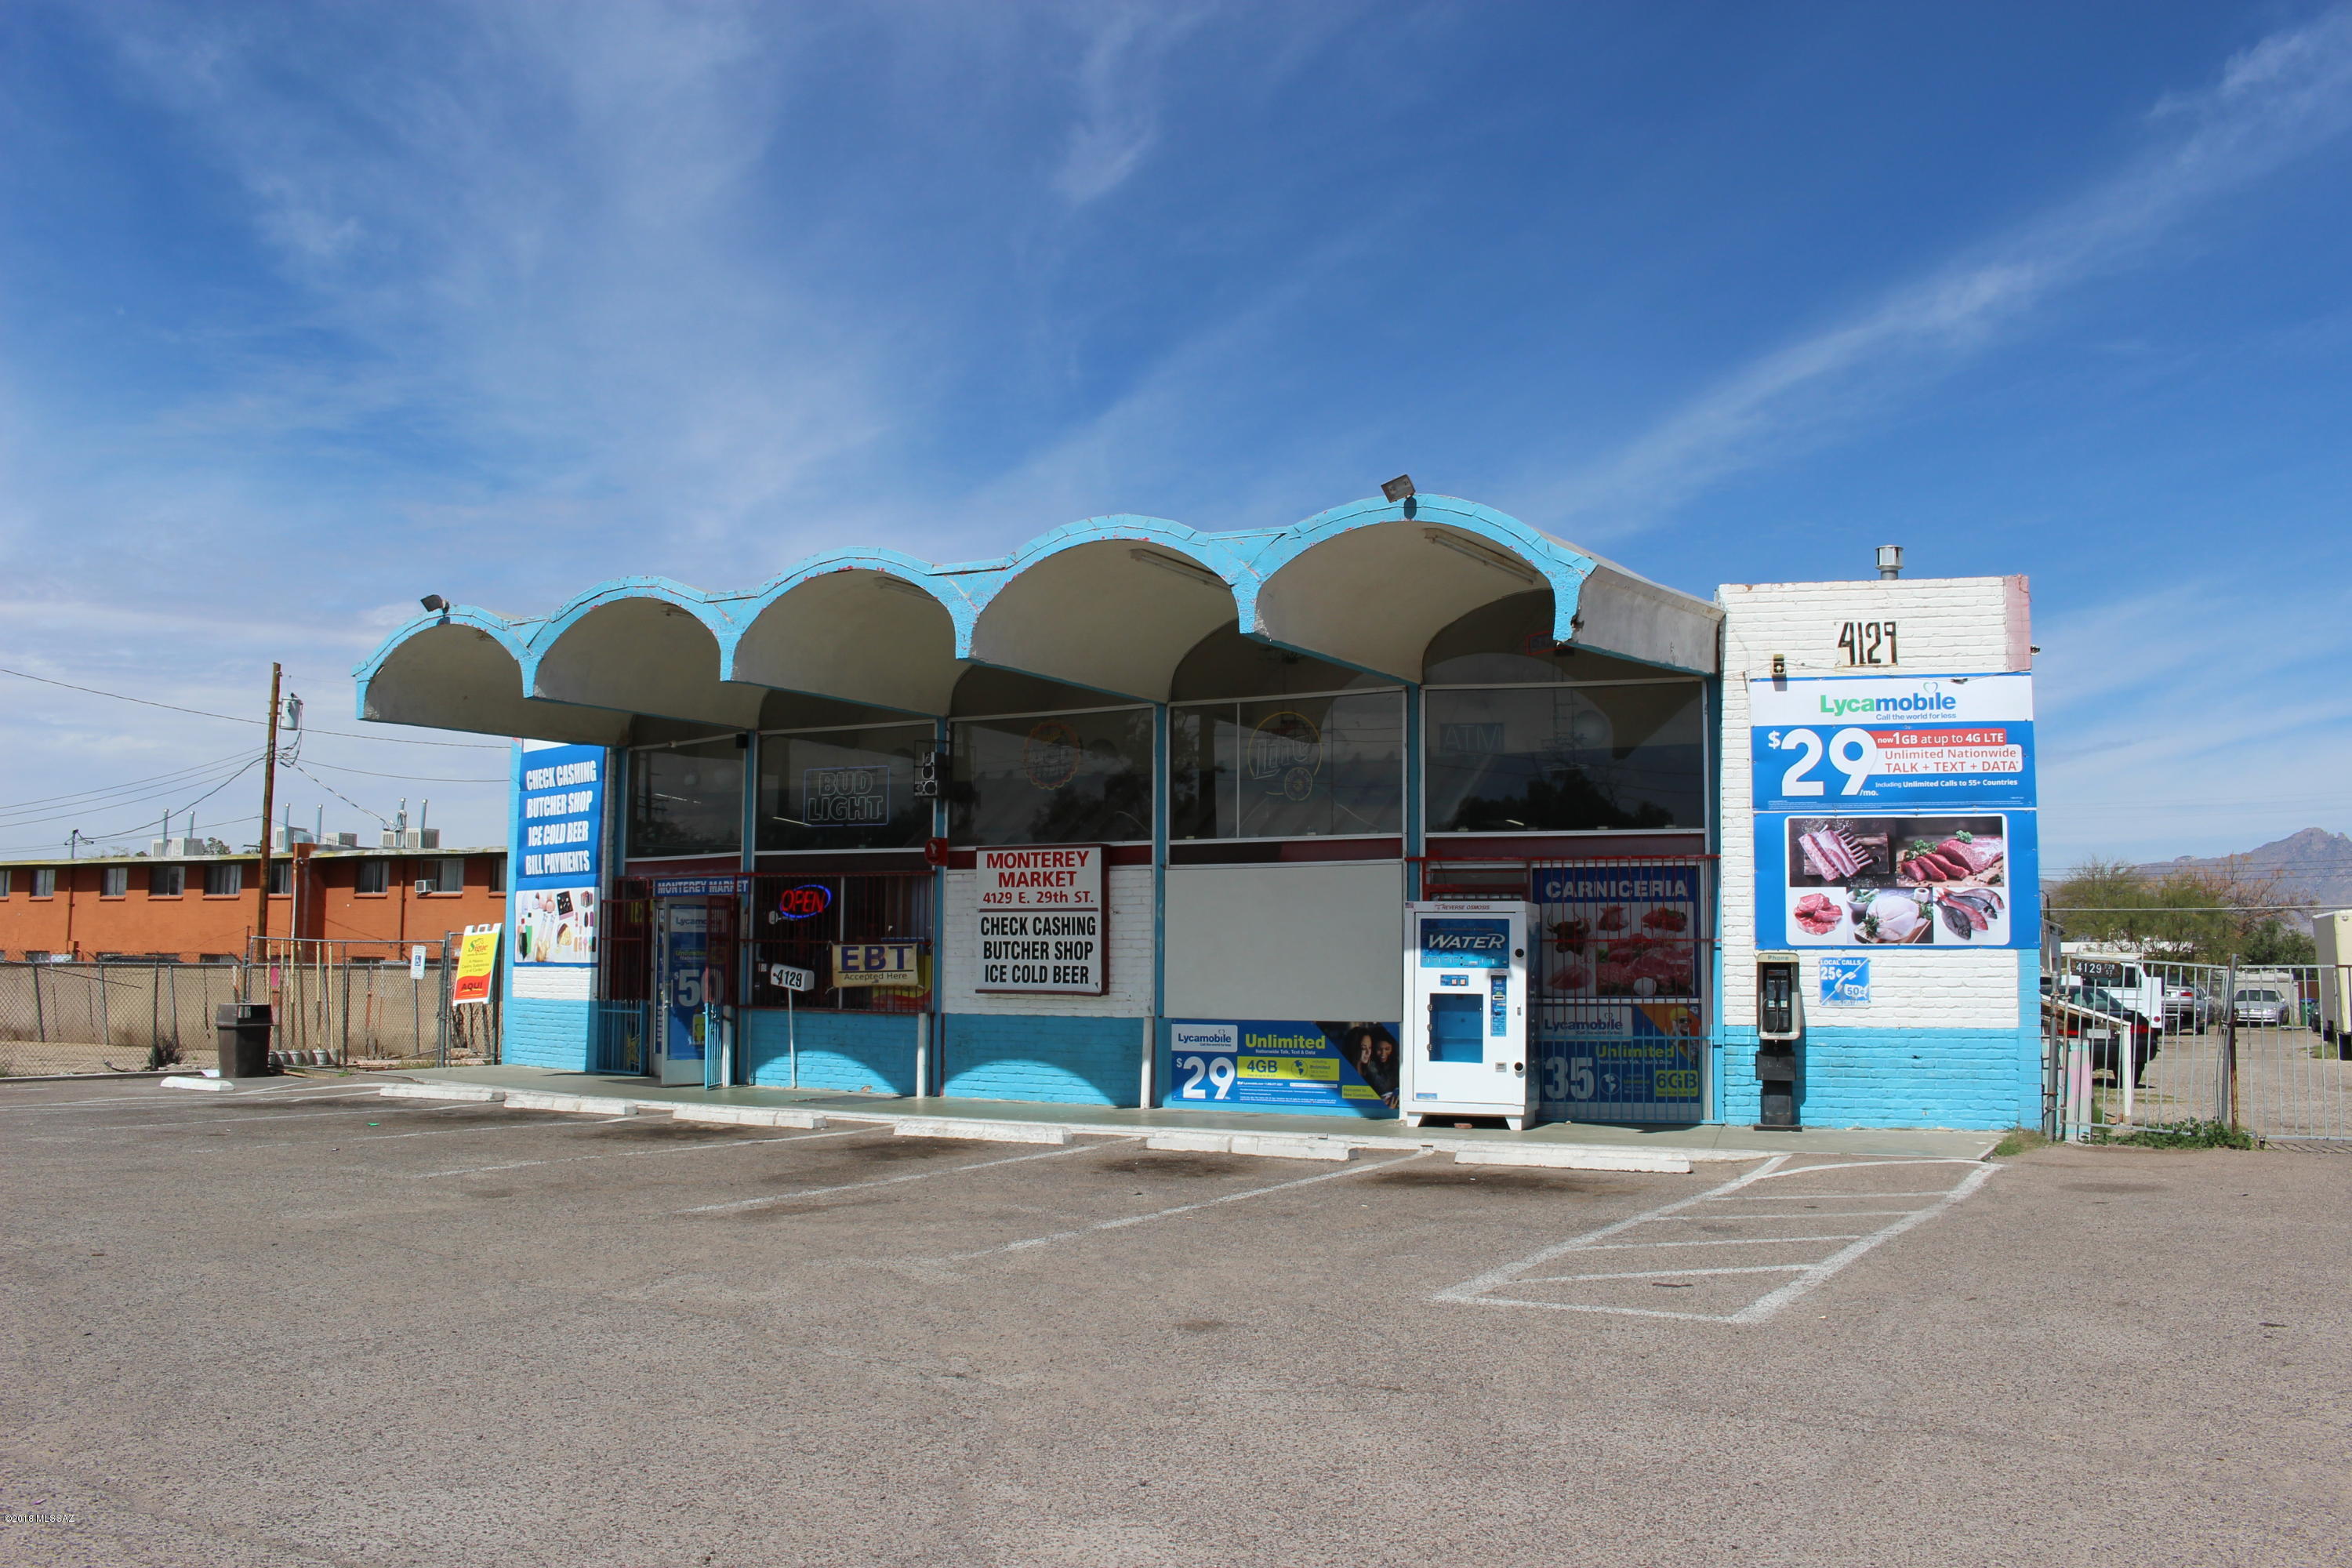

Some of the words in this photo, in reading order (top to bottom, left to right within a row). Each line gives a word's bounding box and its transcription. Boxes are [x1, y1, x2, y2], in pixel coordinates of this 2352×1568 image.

[1837, 621, 1897, 666] 4129
[1820, 691, 1956, 717] Lycamobile
[1921, 734, 1932, 744] at
[1934, 735, 1948, 746] up
[1951, 733, 1963, 743] to
[1965, 733, 1981, 743] 4G
[1984, 732, 2004, 742] LTE
[1885, 748, 1944, 760] Unlimited
[1947, 747, 2016, 758] Nationwide
[526, 767, 555, 791] CHECK
[556, 760, 597, 786] CASHING
[1885, 762, 1918, 773] TALK
[1933, 760, 1966, 772] TEXT
[818, 771, 873, 797] BUD
[526, 793, 567, 818] BUTCHER
[568, 790, 593, 814] SHOP
[808, 795, 884, 821] LIGHT
[528, 826, 543, 847] ICE
[543, 822, 566, 845] COLD
[566, 821, 590, 844] BEER
[525, 855, 543, 875] BILL
[544, 850, 590, 874] PAYMENTS
[986, 850, 1090, 869] MONTEREY
[658, 880, 706, 894] MONTEREY
[998, 871, 1077, 888] MARKET
[982, 891, 1012, 904] 4129
[1018, 891, 1030, 904] E.
[1036, 891, 1069, 903] 29th
[1074, 891, 1094, 903] ST.
[1545, 880, 1688, 898] CARNICERIA
[781, 889, 826, 913] OPEN
[981, 916, 1029, 936] CHECK
[1033, 916, 1096, 936] CASHING
[1428, 933, 1505, 949] WATER
[841, 945, 913, 971] EBT
[983, 941, 1050, 960] BUTCHER
[1054, 941, 1094, 960] SHOP
[844, 972, 884, 982] Accepted
[886, 971, 908, 980] Here
[985, 964, 1007, 983] ICE
[1011, 964, 1048, 983] COLD
[1053, 965, 1089, 984] BEER
[2075, 962, 2102, 974] 4129
[776, 969, 803, 988] 4129
[1544, 1018, 1623, 1033] Lycamobile
[1178, 1033, 1232, 1044] Lycamobile
[1245, 1033, 1326, 1050] Unlimited
[1595, 1045, 1675, 1058] Unlimited
[1247, 1059, 1278, 1073] 4GB
[1656, 1072, 1697, 1089] 6GB
